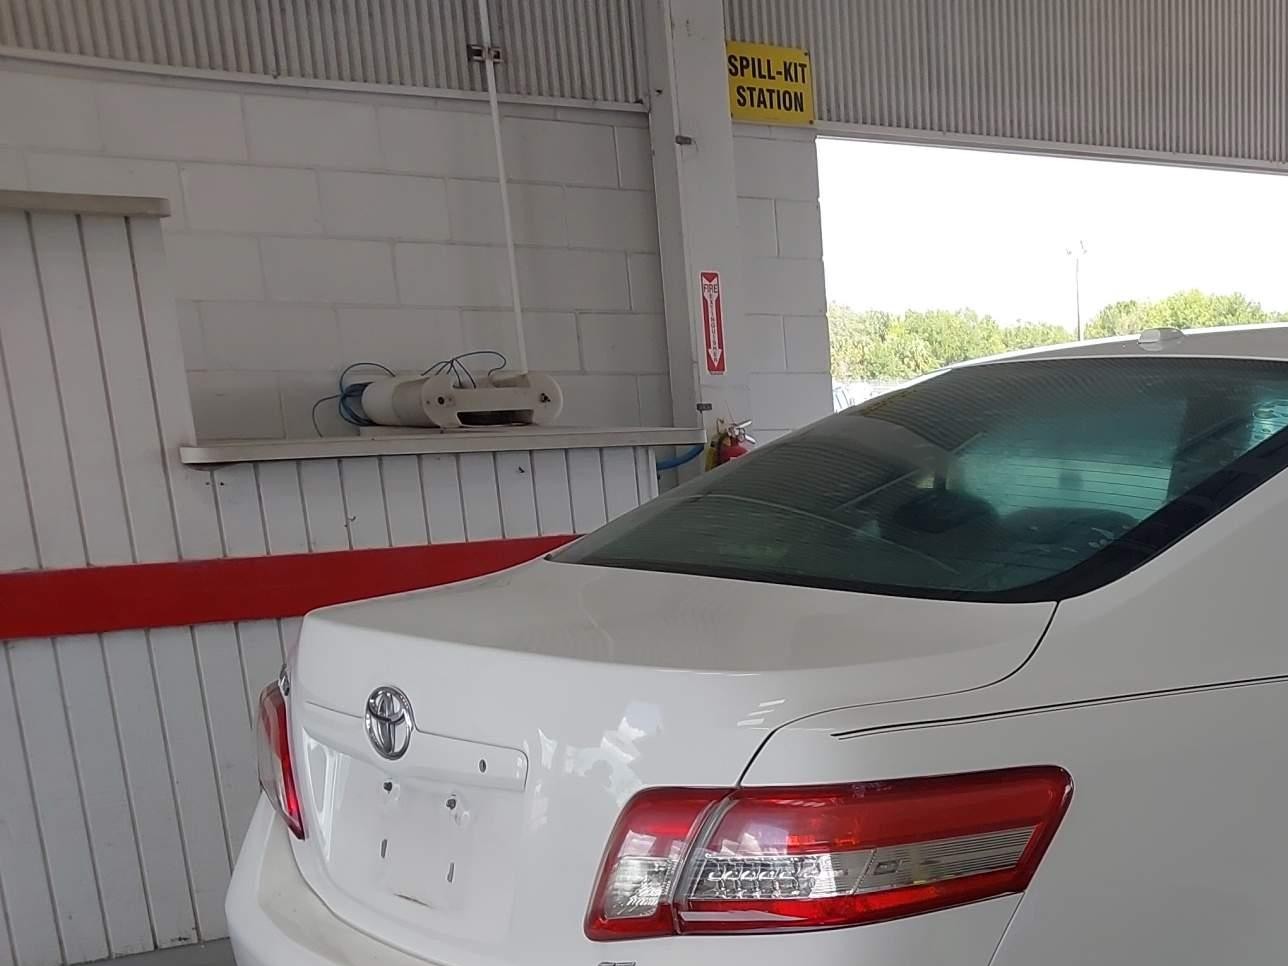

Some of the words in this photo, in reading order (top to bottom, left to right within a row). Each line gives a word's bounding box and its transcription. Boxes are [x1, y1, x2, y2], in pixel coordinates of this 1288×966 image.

[728, 54, 807, 84] SPILL-KIT
[736, 85, 804, 112] STATION
[703, 283, 719, 293] FIRE
